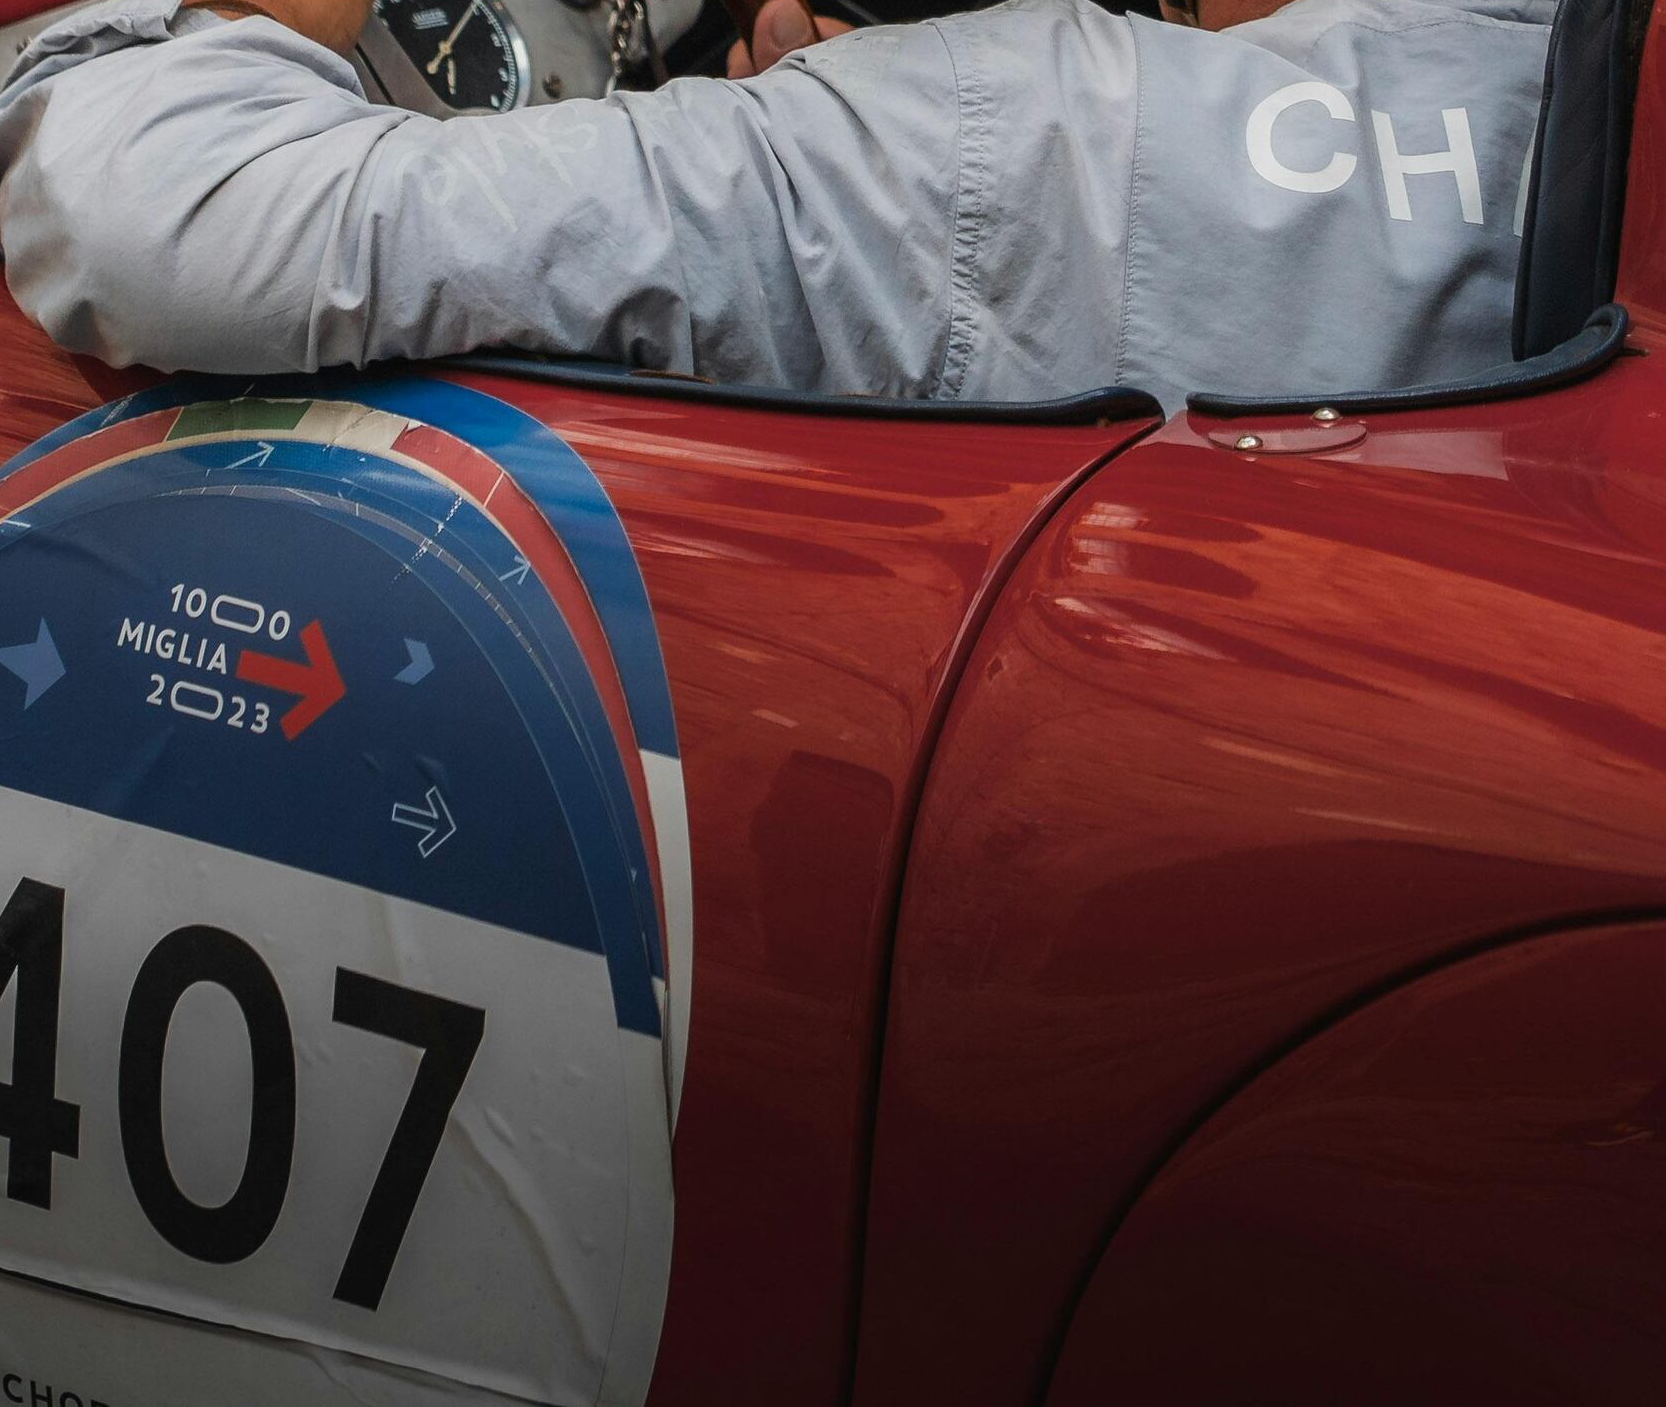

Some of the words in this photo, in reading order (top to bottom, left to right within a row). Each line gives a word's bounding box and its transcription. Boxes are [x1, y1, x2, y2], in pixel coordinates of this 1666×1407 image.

[1246, 81, 1533, 237] CH
[171, 583, 291, 641] 1000
[117, 617, 228, 675] MIGLIA
[146, 673, 271, 734] 2023
[2, 1373, 110, 1407] CHO
